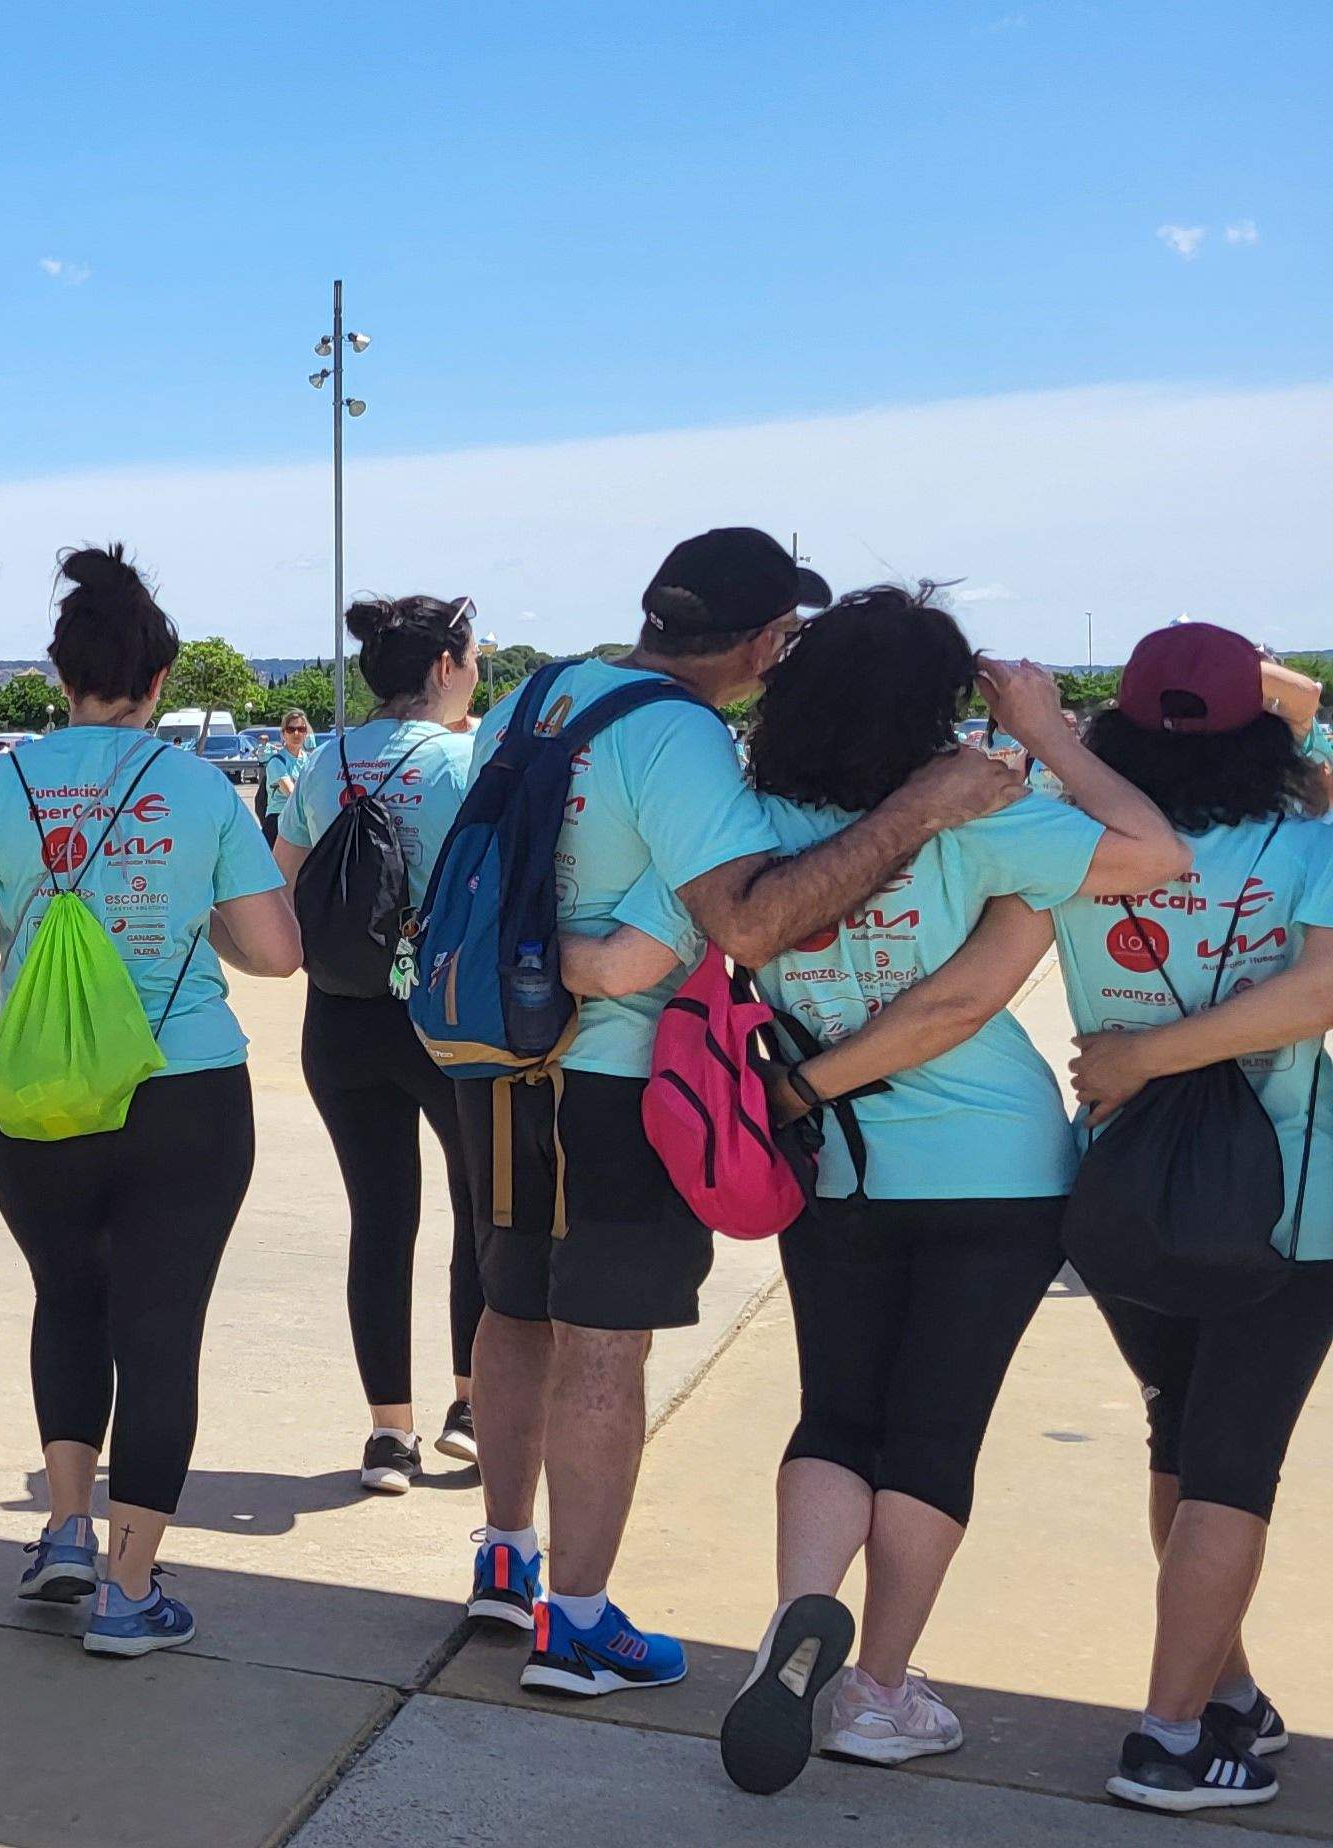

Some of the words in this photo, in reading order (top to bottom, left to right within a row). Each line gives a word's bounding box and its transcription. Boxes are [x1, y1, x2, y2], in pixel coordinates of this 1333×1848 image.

[29, 803, 116, 821] iberCja
[105, 894, 169, 905] escanero
[785, 969, 836, 981] avanza
[1102, 987, 1166, 1001] avanza
